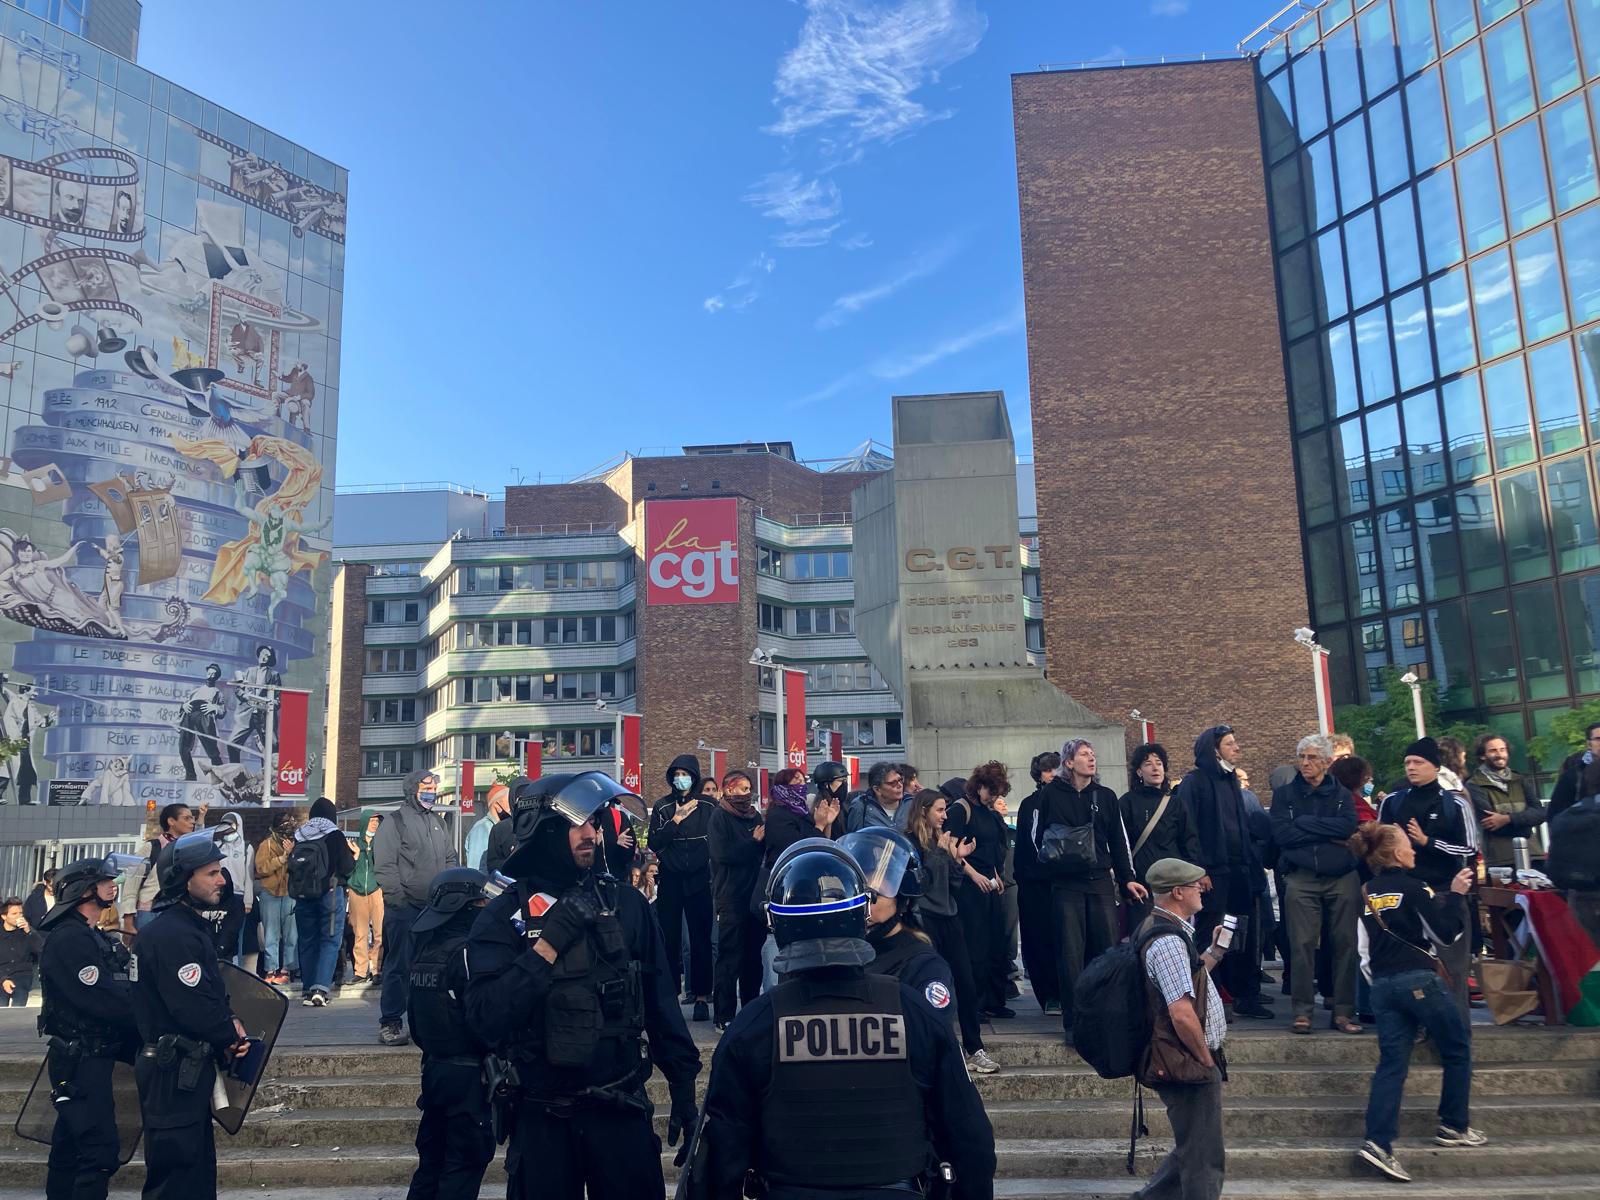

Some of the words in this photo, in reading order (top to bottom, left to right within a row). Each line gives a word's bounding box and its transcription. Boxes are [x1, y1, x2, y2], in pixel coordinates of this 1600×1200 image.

[113, 375, 128, 386] LE
[94, 396, 119, 410] 1912
[66, 437, 87, 448] AUX
[654, 518, 736, 552] la
[905, 545, 1014, 572] C.G.T.
[649, 540, 739, 598] cgt
[908, 623, 1017, 635] ORGANISMES
[73, 648, 88, 659] LE
[103, 650, 141, 663] DIABLE
[90, 679, 105, 692] LE
[109, 679, 144, 694] LIVRE
[149, 685, 191, 699] MAGIQUE
[790, 750, 805, 767] cgt
[280, 768, 303, 785] cgt
[625, 775, 638, 787] cgt
[141, 786, 182, 799] CARTES
[191, 787, 215, 800] 1896
[785, 1016, 900, 1057] POLICE
